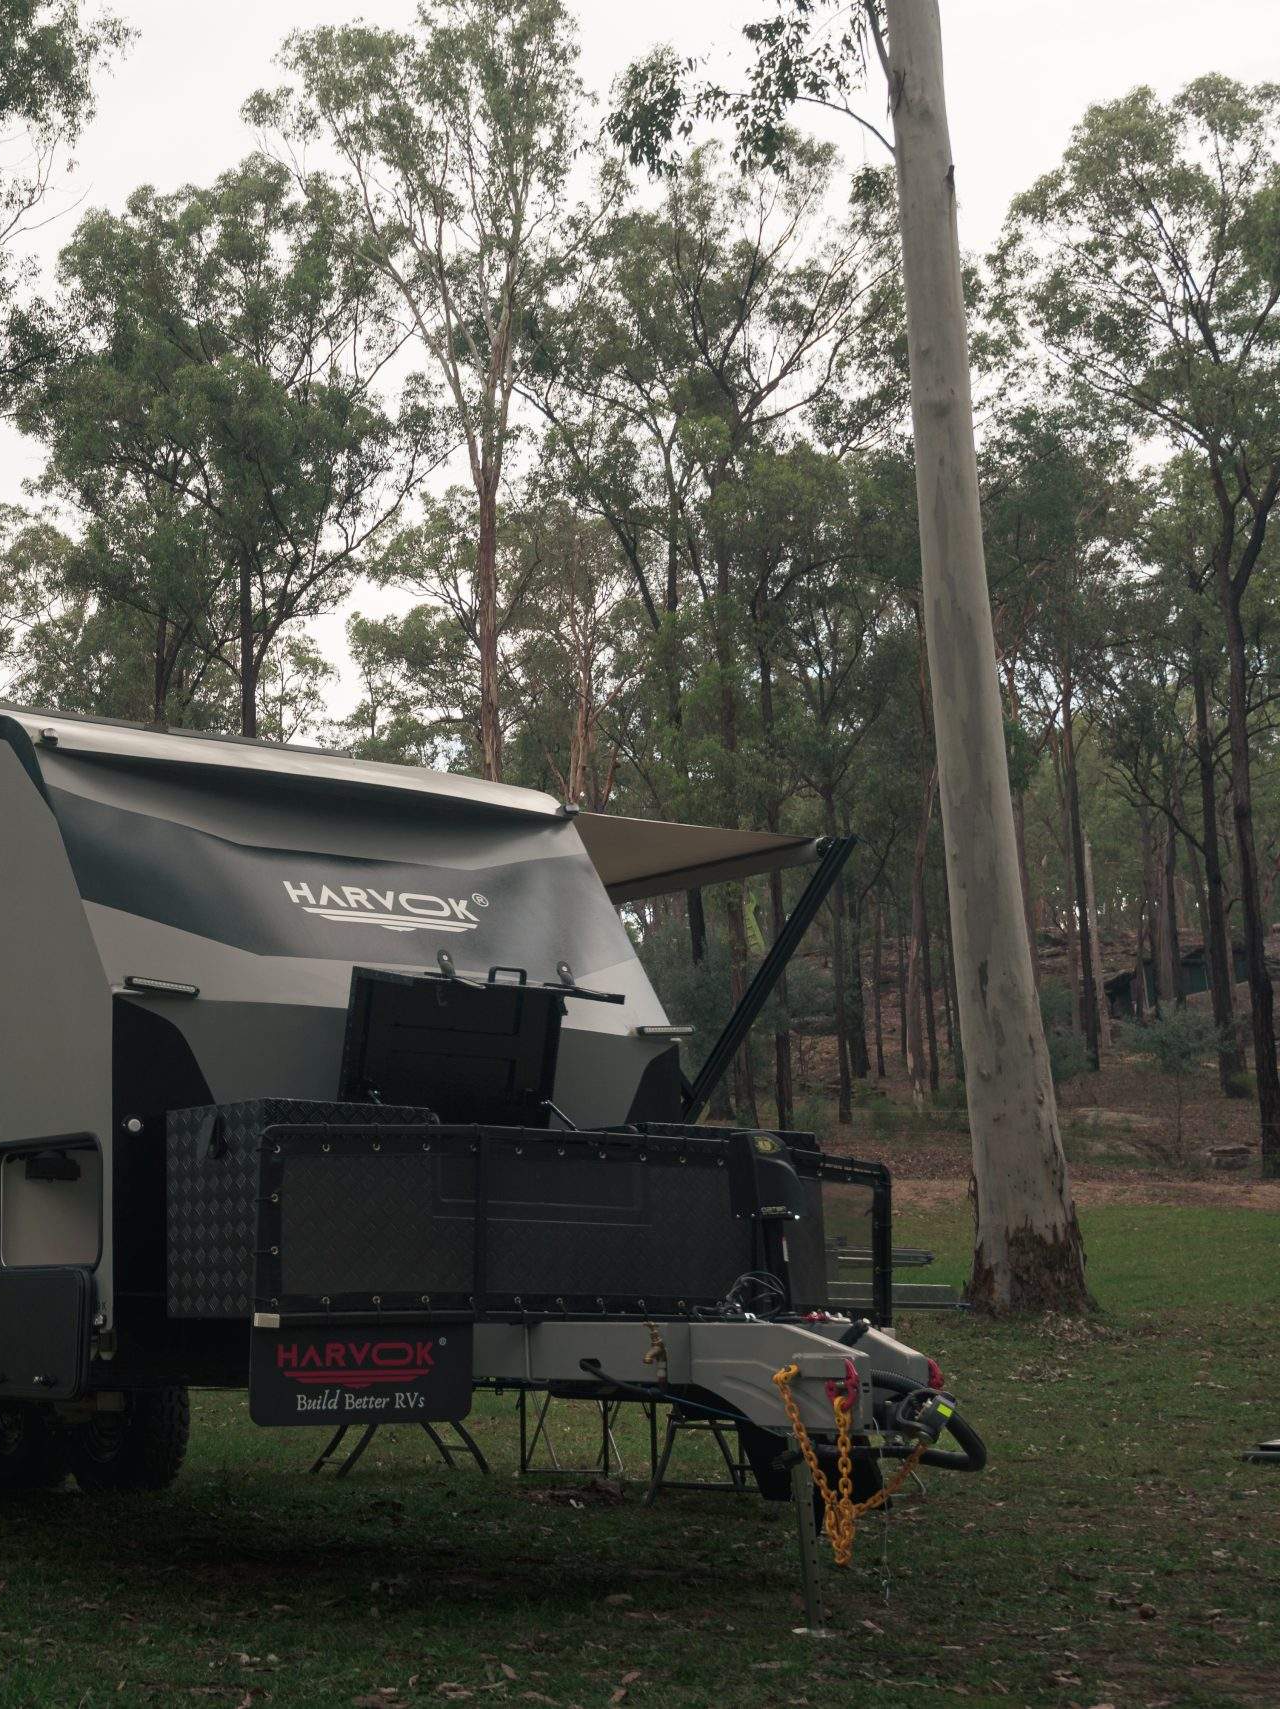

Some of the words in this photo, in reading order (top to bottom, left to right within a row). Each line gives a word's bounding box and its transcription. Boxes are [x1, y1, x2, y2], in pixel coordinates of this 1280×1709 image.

[296, 1389, 340, 1412] Build
[344, 1393, 390, 1411] Better
[394, 1391, 426, 1409] RVs
